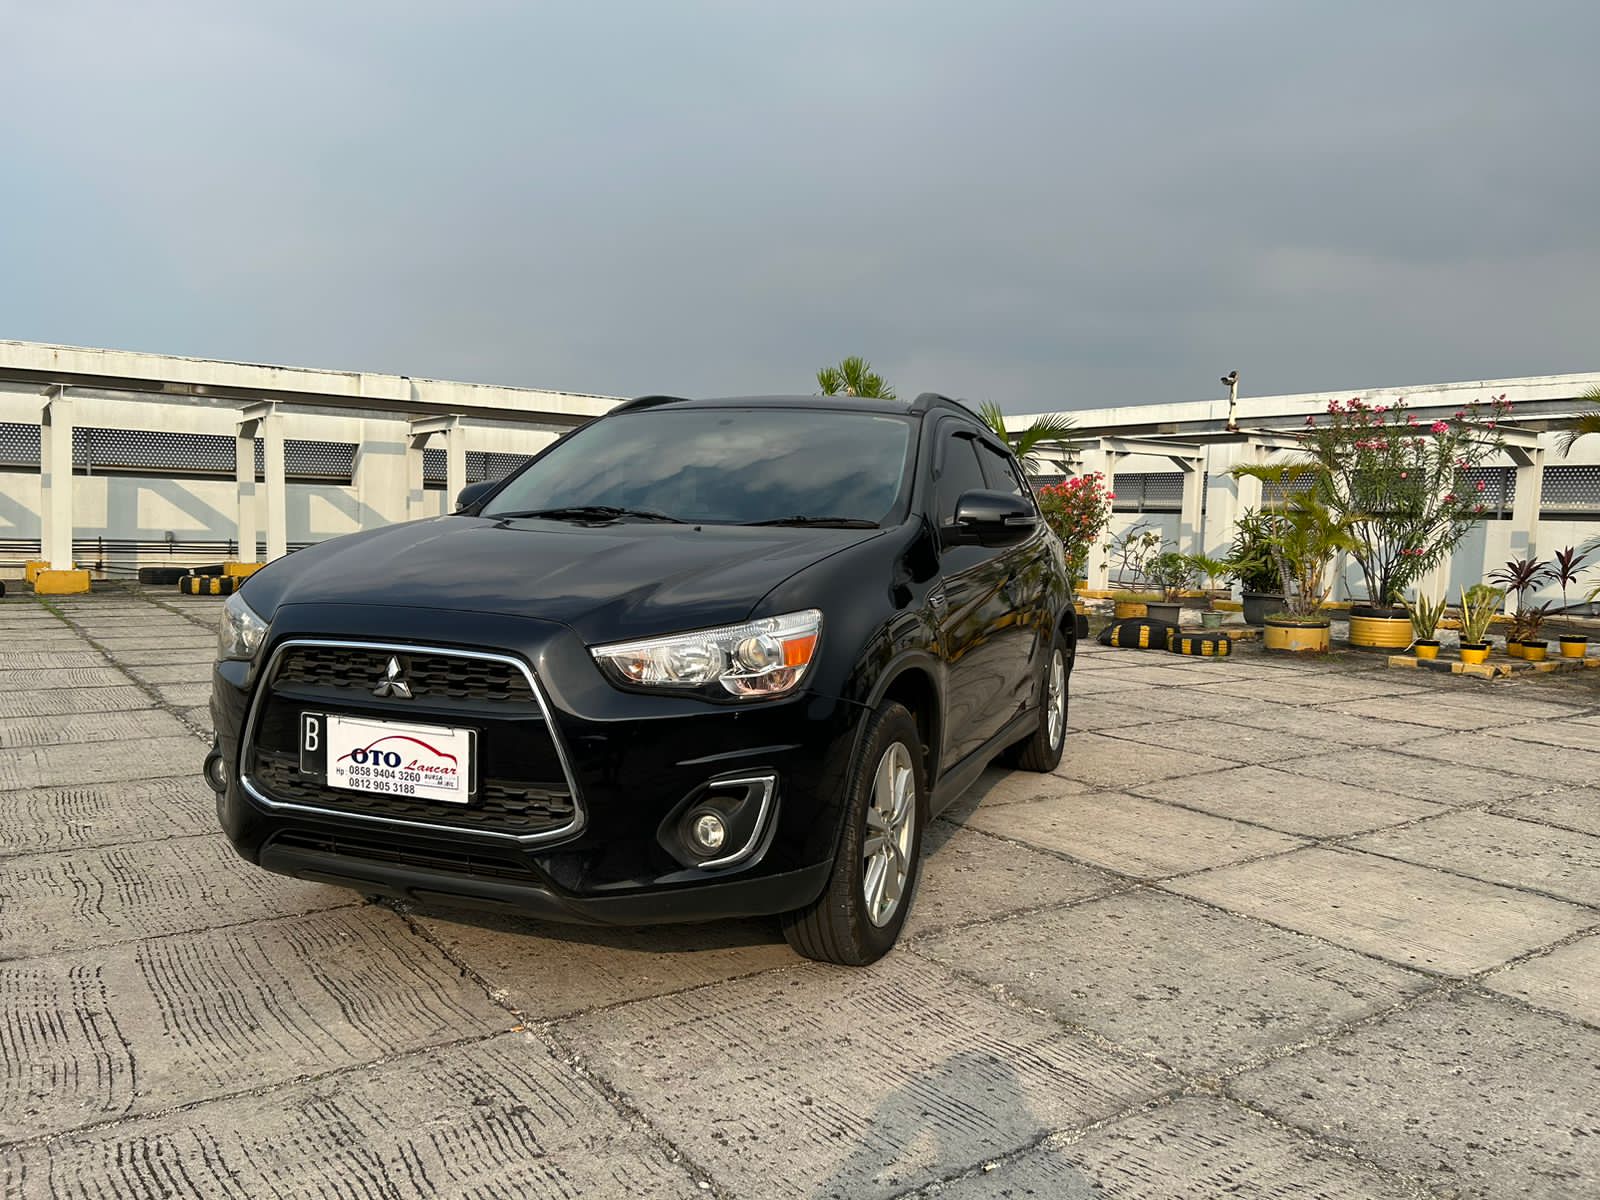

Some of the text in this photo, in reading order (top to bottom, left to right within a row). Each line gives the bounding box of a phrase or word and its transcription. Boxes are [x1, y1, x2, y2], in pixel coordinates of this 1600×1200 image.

[305, 717, 319, 751] B
[351, 748, 457, 775] OTO Lancar
[349, 765, 371, 777] 0858
[373, 768, 396, 779] 9404
[398, 770, 421, 782] 3260
[349, 777, 415, 795] 0812 905 3188
